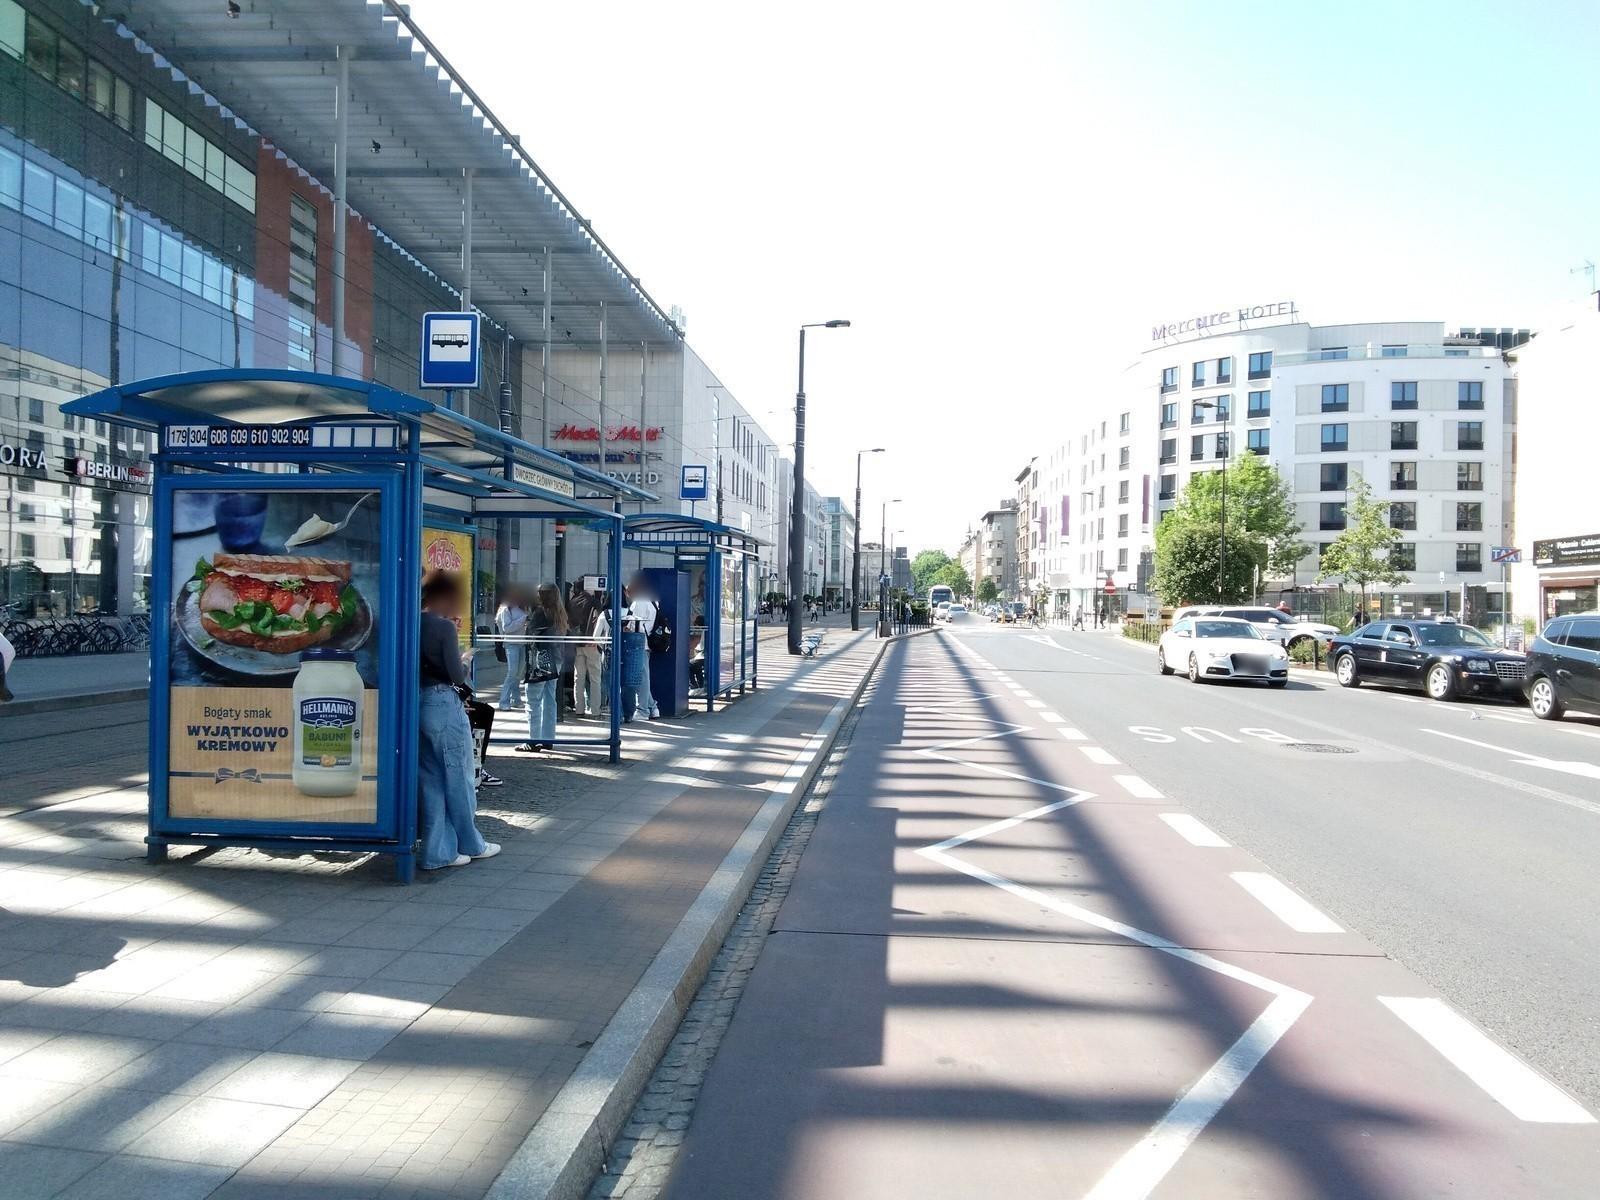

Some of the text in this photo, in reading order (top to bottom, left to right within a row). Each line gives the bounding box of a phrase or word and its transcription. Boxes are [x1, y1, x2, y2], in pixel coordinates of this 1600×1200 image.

[1151, 301, 1299, 341] Mercure HOTEL
[171, 429, 309, 446] 179 304 608 609 610 902 904
[86, 461, 129, 481] BERLIN
[1492, 549, 1520, 561] TAXI
[204, 706, 272, 720] Bogaty smak
[302, 702, 354, 716] HELLMANN'S
[187, 725, 289, 740] WYJĄTKOWO
[1128, 726, 1306, 743] BUS
[197, 740, 278, 752] KREMOWY
